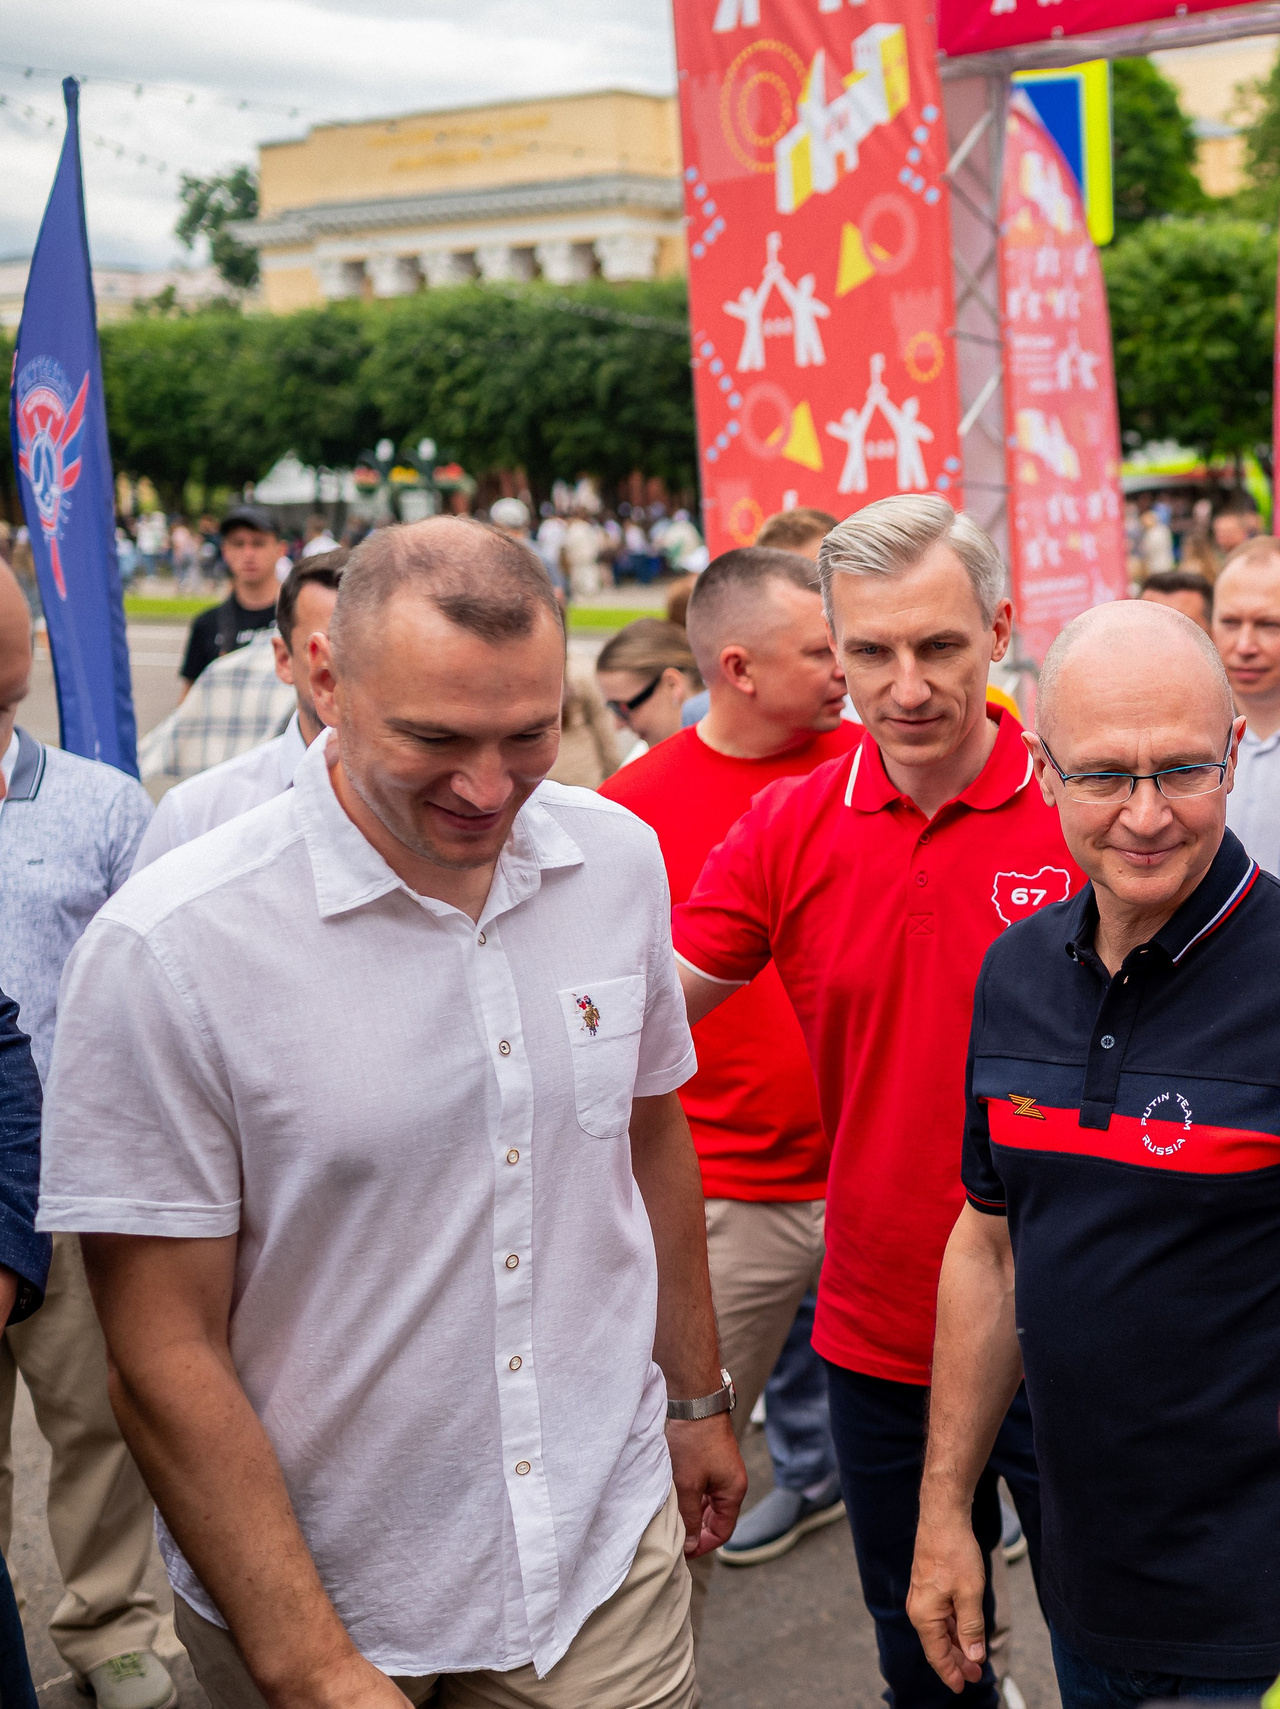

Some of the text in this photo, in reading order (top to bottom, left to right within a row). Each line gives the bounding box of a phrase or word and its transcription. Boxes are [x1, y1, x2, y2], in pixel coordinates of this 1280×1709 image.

[1011, 887, 1047, 906] 67
[1140, 1091, 1193, 1131] PUTIN TEAM
[1142, 1133, 1187, 1156] RUSSIA
